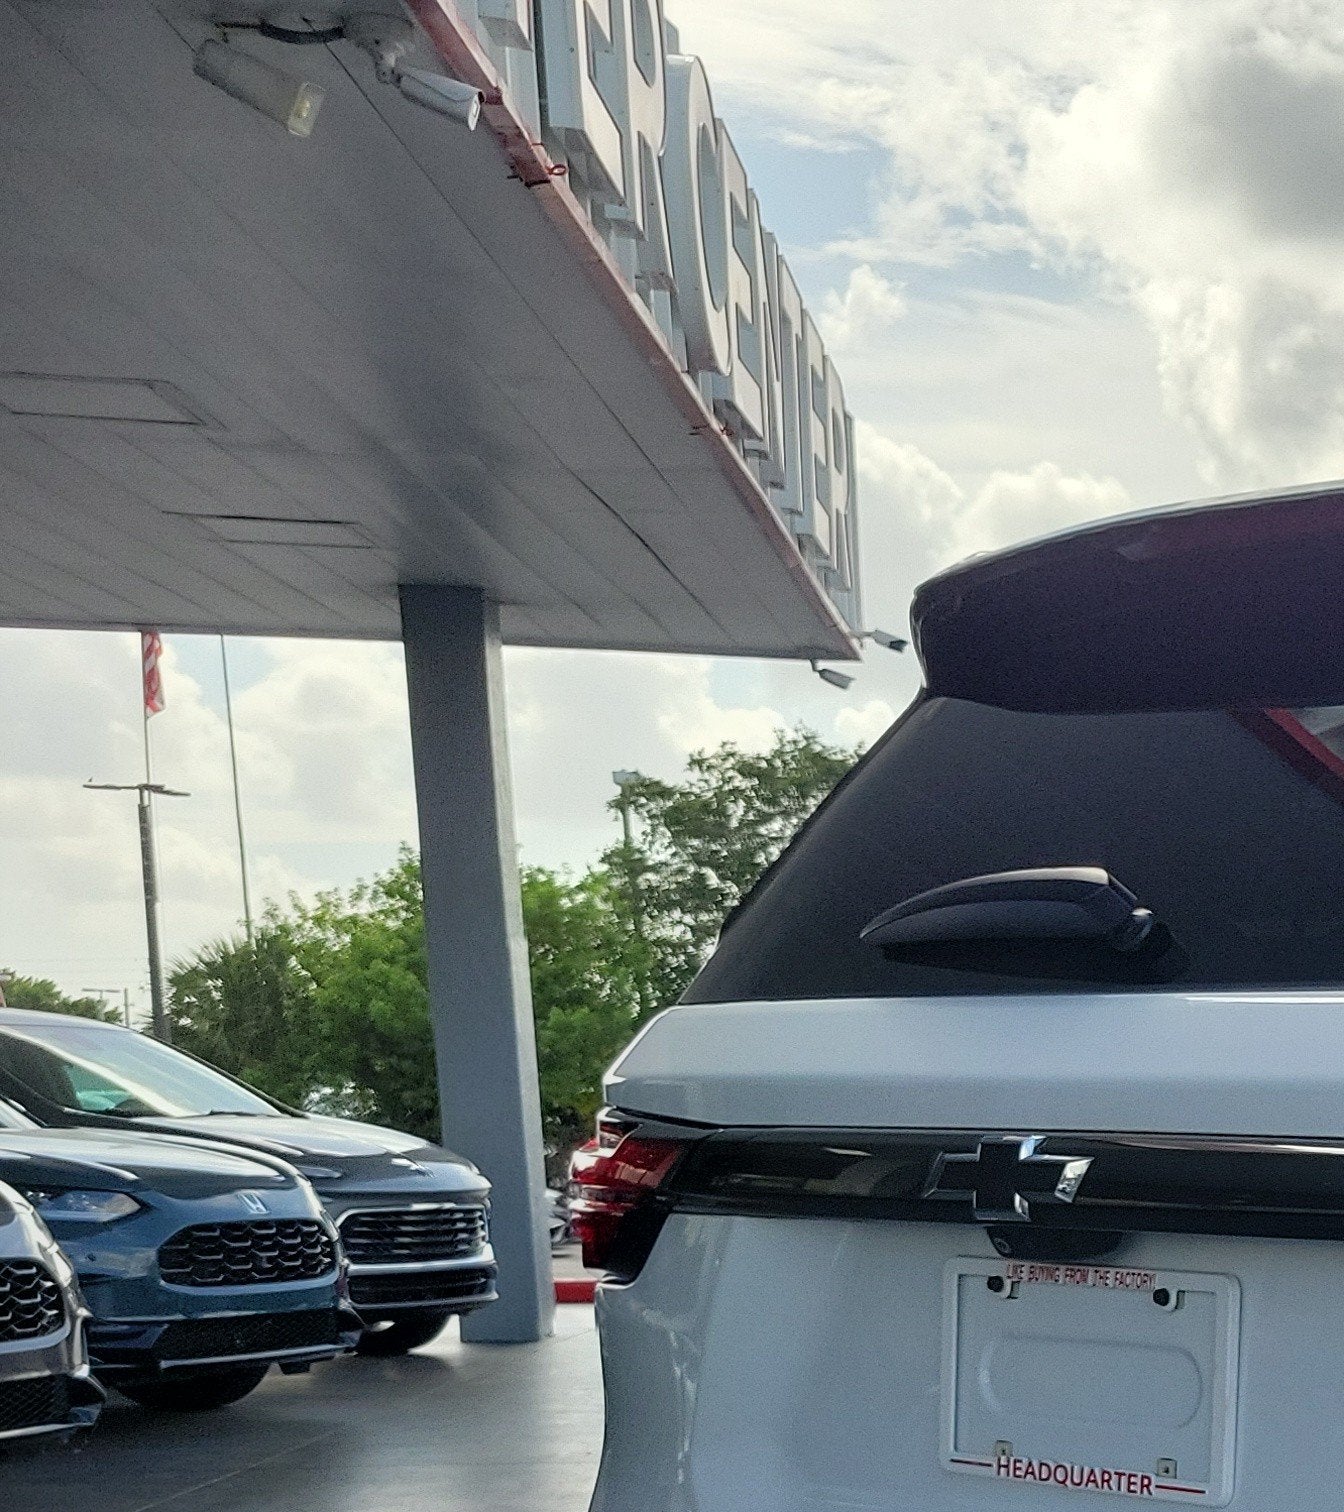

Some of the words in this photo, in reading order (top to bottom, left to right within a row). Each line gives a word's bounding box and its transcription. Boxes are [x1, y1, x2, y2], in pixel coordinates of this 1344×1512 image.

[1028, 1265, 1060, 1282] BUYING
[1064, 1267, 1089, 1285] FROM
[1094, 1269, 1111, 1287] THE
[996, 1456, 1154, 1497] HEADQUARTER
